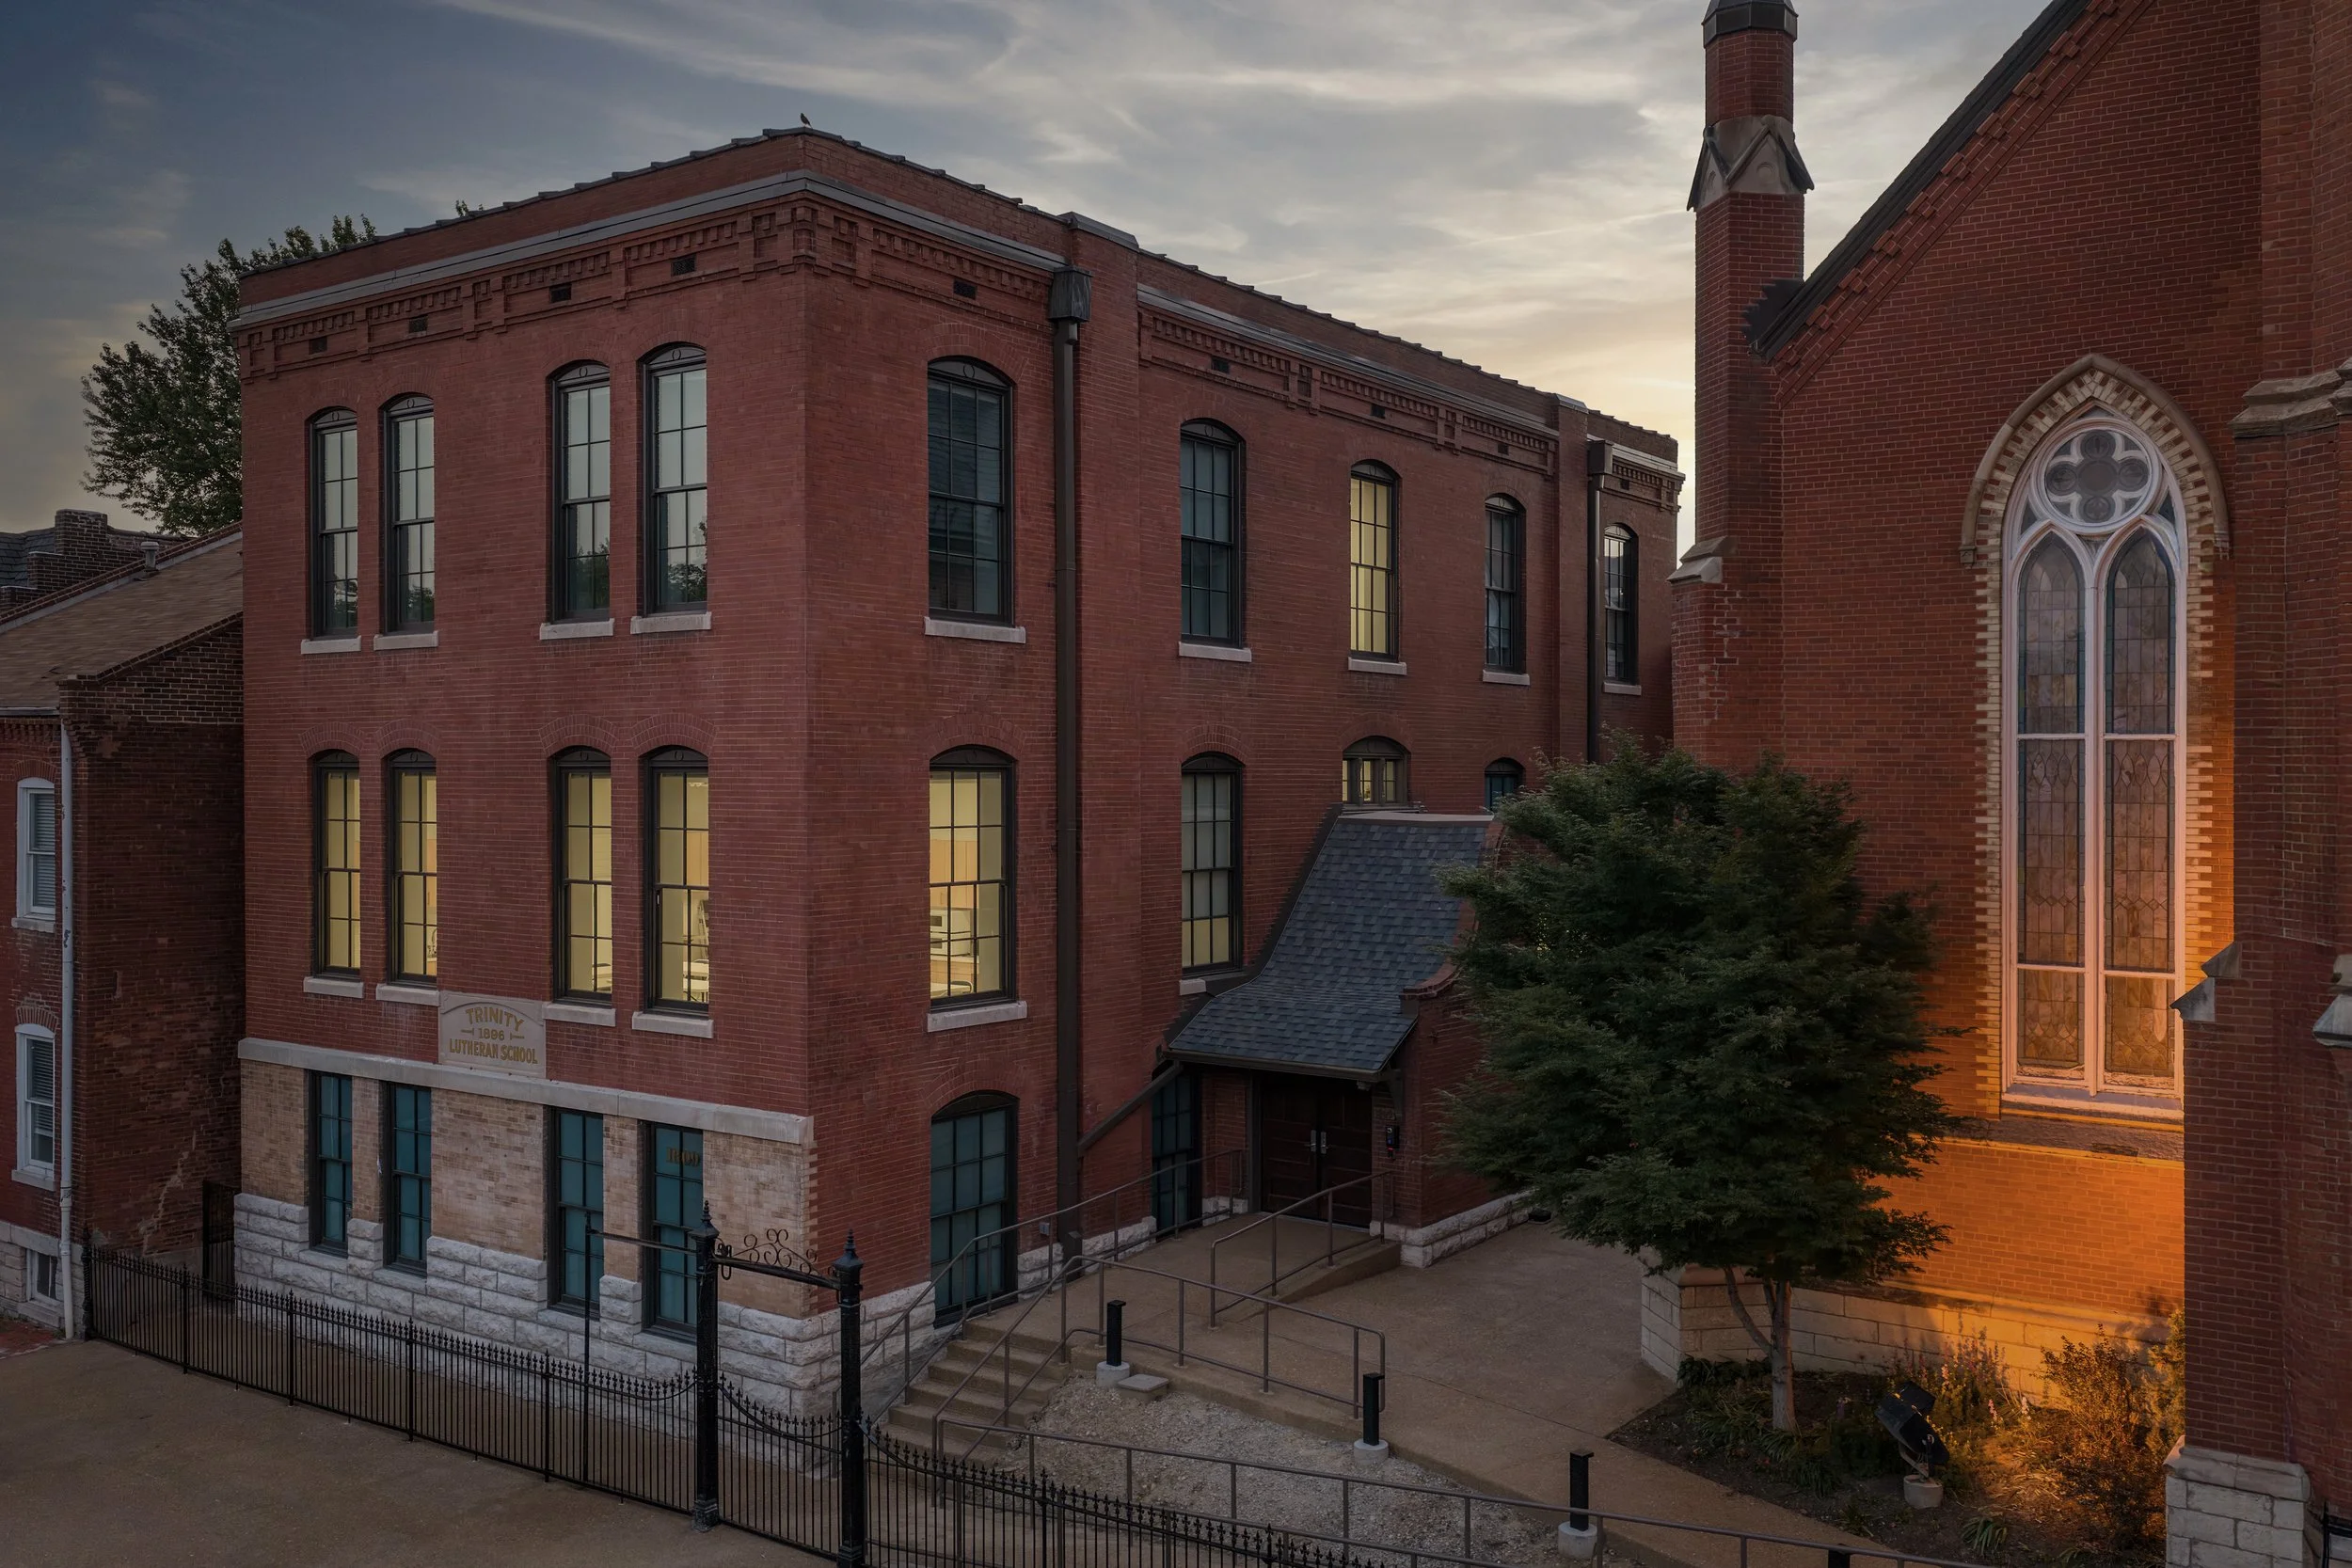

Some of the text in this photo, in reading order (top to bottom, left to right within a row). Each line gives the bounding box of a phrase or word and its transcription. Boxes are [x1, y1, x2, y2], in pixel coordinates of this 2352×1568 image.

[466, 1006, 525, 1032] TRINITY
[449, 1037, 538, 1065] LUTHERAN SCHOOL
